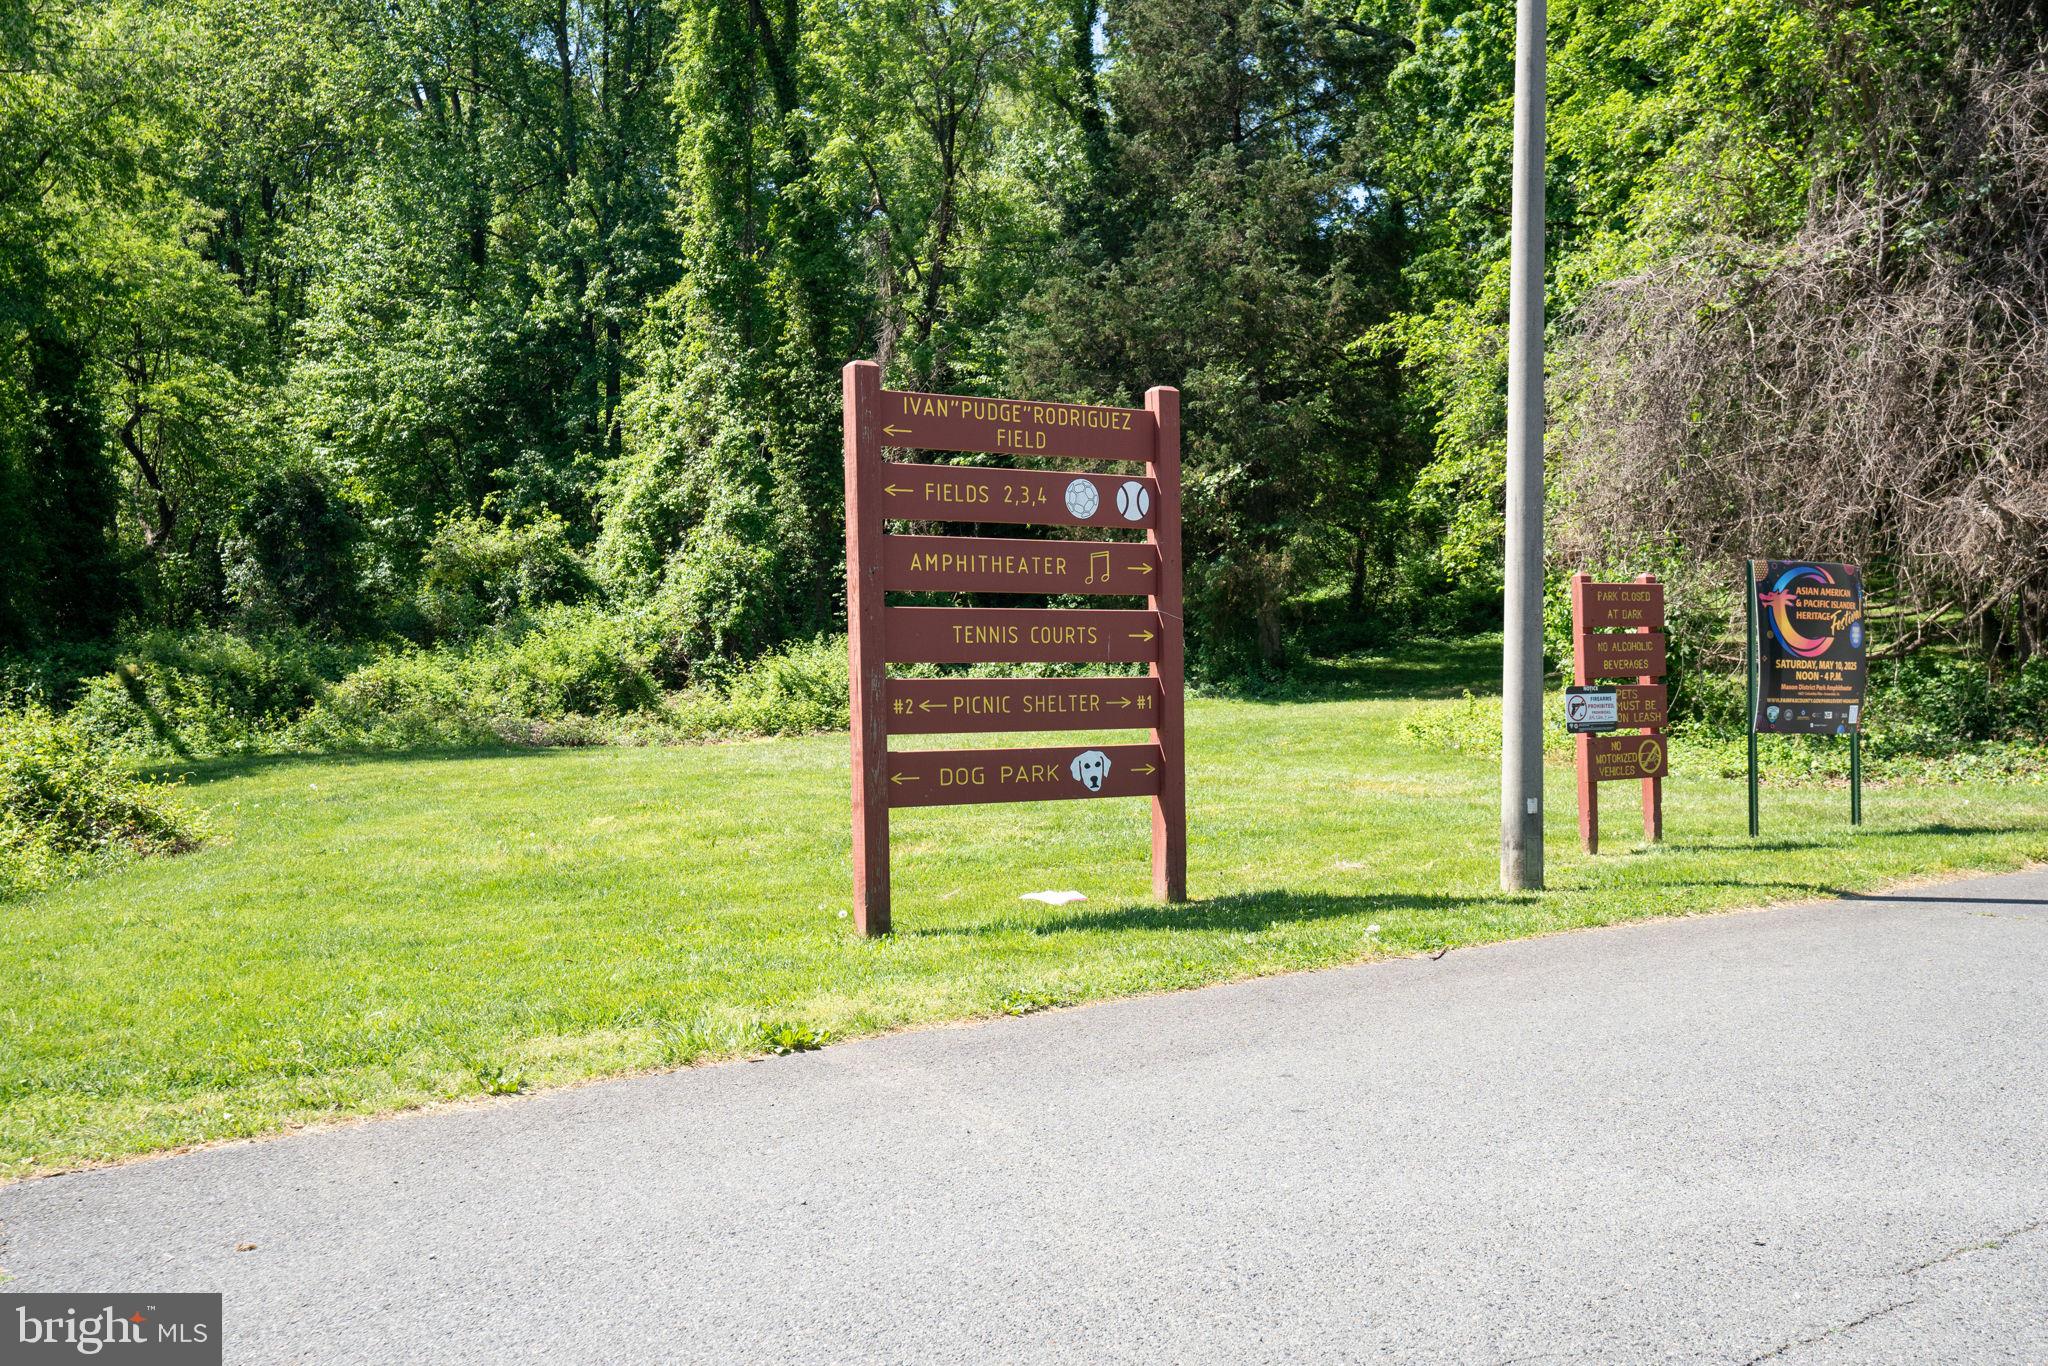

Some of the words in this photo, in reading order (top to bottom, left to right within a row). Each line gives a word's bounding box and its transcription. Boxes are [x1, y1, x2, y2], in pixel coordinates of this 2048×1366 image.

[997, 429, 1046, 449] FIELD
[926, 483, 989, 503] FIELDS
[1004, 485, 1047, 507] 2,3,4
[911, 553, 1066, 575] AMPHITHEATER
[1597, 591, 1618, 602] PARK
[1622, 591, 1651, 602] CLOSED
[1796, 586, 1819, 596] ASIAN
[1820, 587, 1851, 598] AMERICAN
[1795, 599, 1802, 608] &
[1803, 599, 1831, 608] PACIFIC
[1831, 600, 1857, 610] ISLANDER
[1607, 609, 1618, 619] AT
[1622, 609, 1642, 619] DARK
[1796, 611, 1831, 621] HERITAGE
[953, 625, 1018, 644] TENNIS
[1031, 626, 1097, 644] COURTS
[1597, 642, 1608, 652] NO
[1612, 641, 1654, 652] ALCOHOLIC
[1603, 659, 1649, 670] BEVERAGES
[1775, 659, 1817, 670] SATURDAY,
[1818, 660, 1835, 670] MAY
[1844, 661, 1858, 671] 2025
[1795, 671, 1819, 681] NOON
[1824, 672, 1829, 681] 4
[1829, 672, 1844, 681] P.M.
[1798, 683, 1816, 691] District
[1616, 688, 1638, 699] PETS
[893, 698, 913, 714] #2
[953, 696, 1011, 714] PICNIC
[1023, 694, 1100, 713] SHELTER
[1136, 695, 1152, 709] #1
[1616, 700, 1640, 711] MUST
[1645, 700, 1656, 710] BE
[1616, 712, 1629, 723] ON
[1634, 712, 1662, 722] LEASH
[1611, 741, 1622, 751] NO
[1596, 752, 1638, 765] MOTORIZED
[940, 767, 984, 786] DOG
[1001, 764, 1059, 783] PARK
[1598, 765, 1636, 777] VEHICLES
